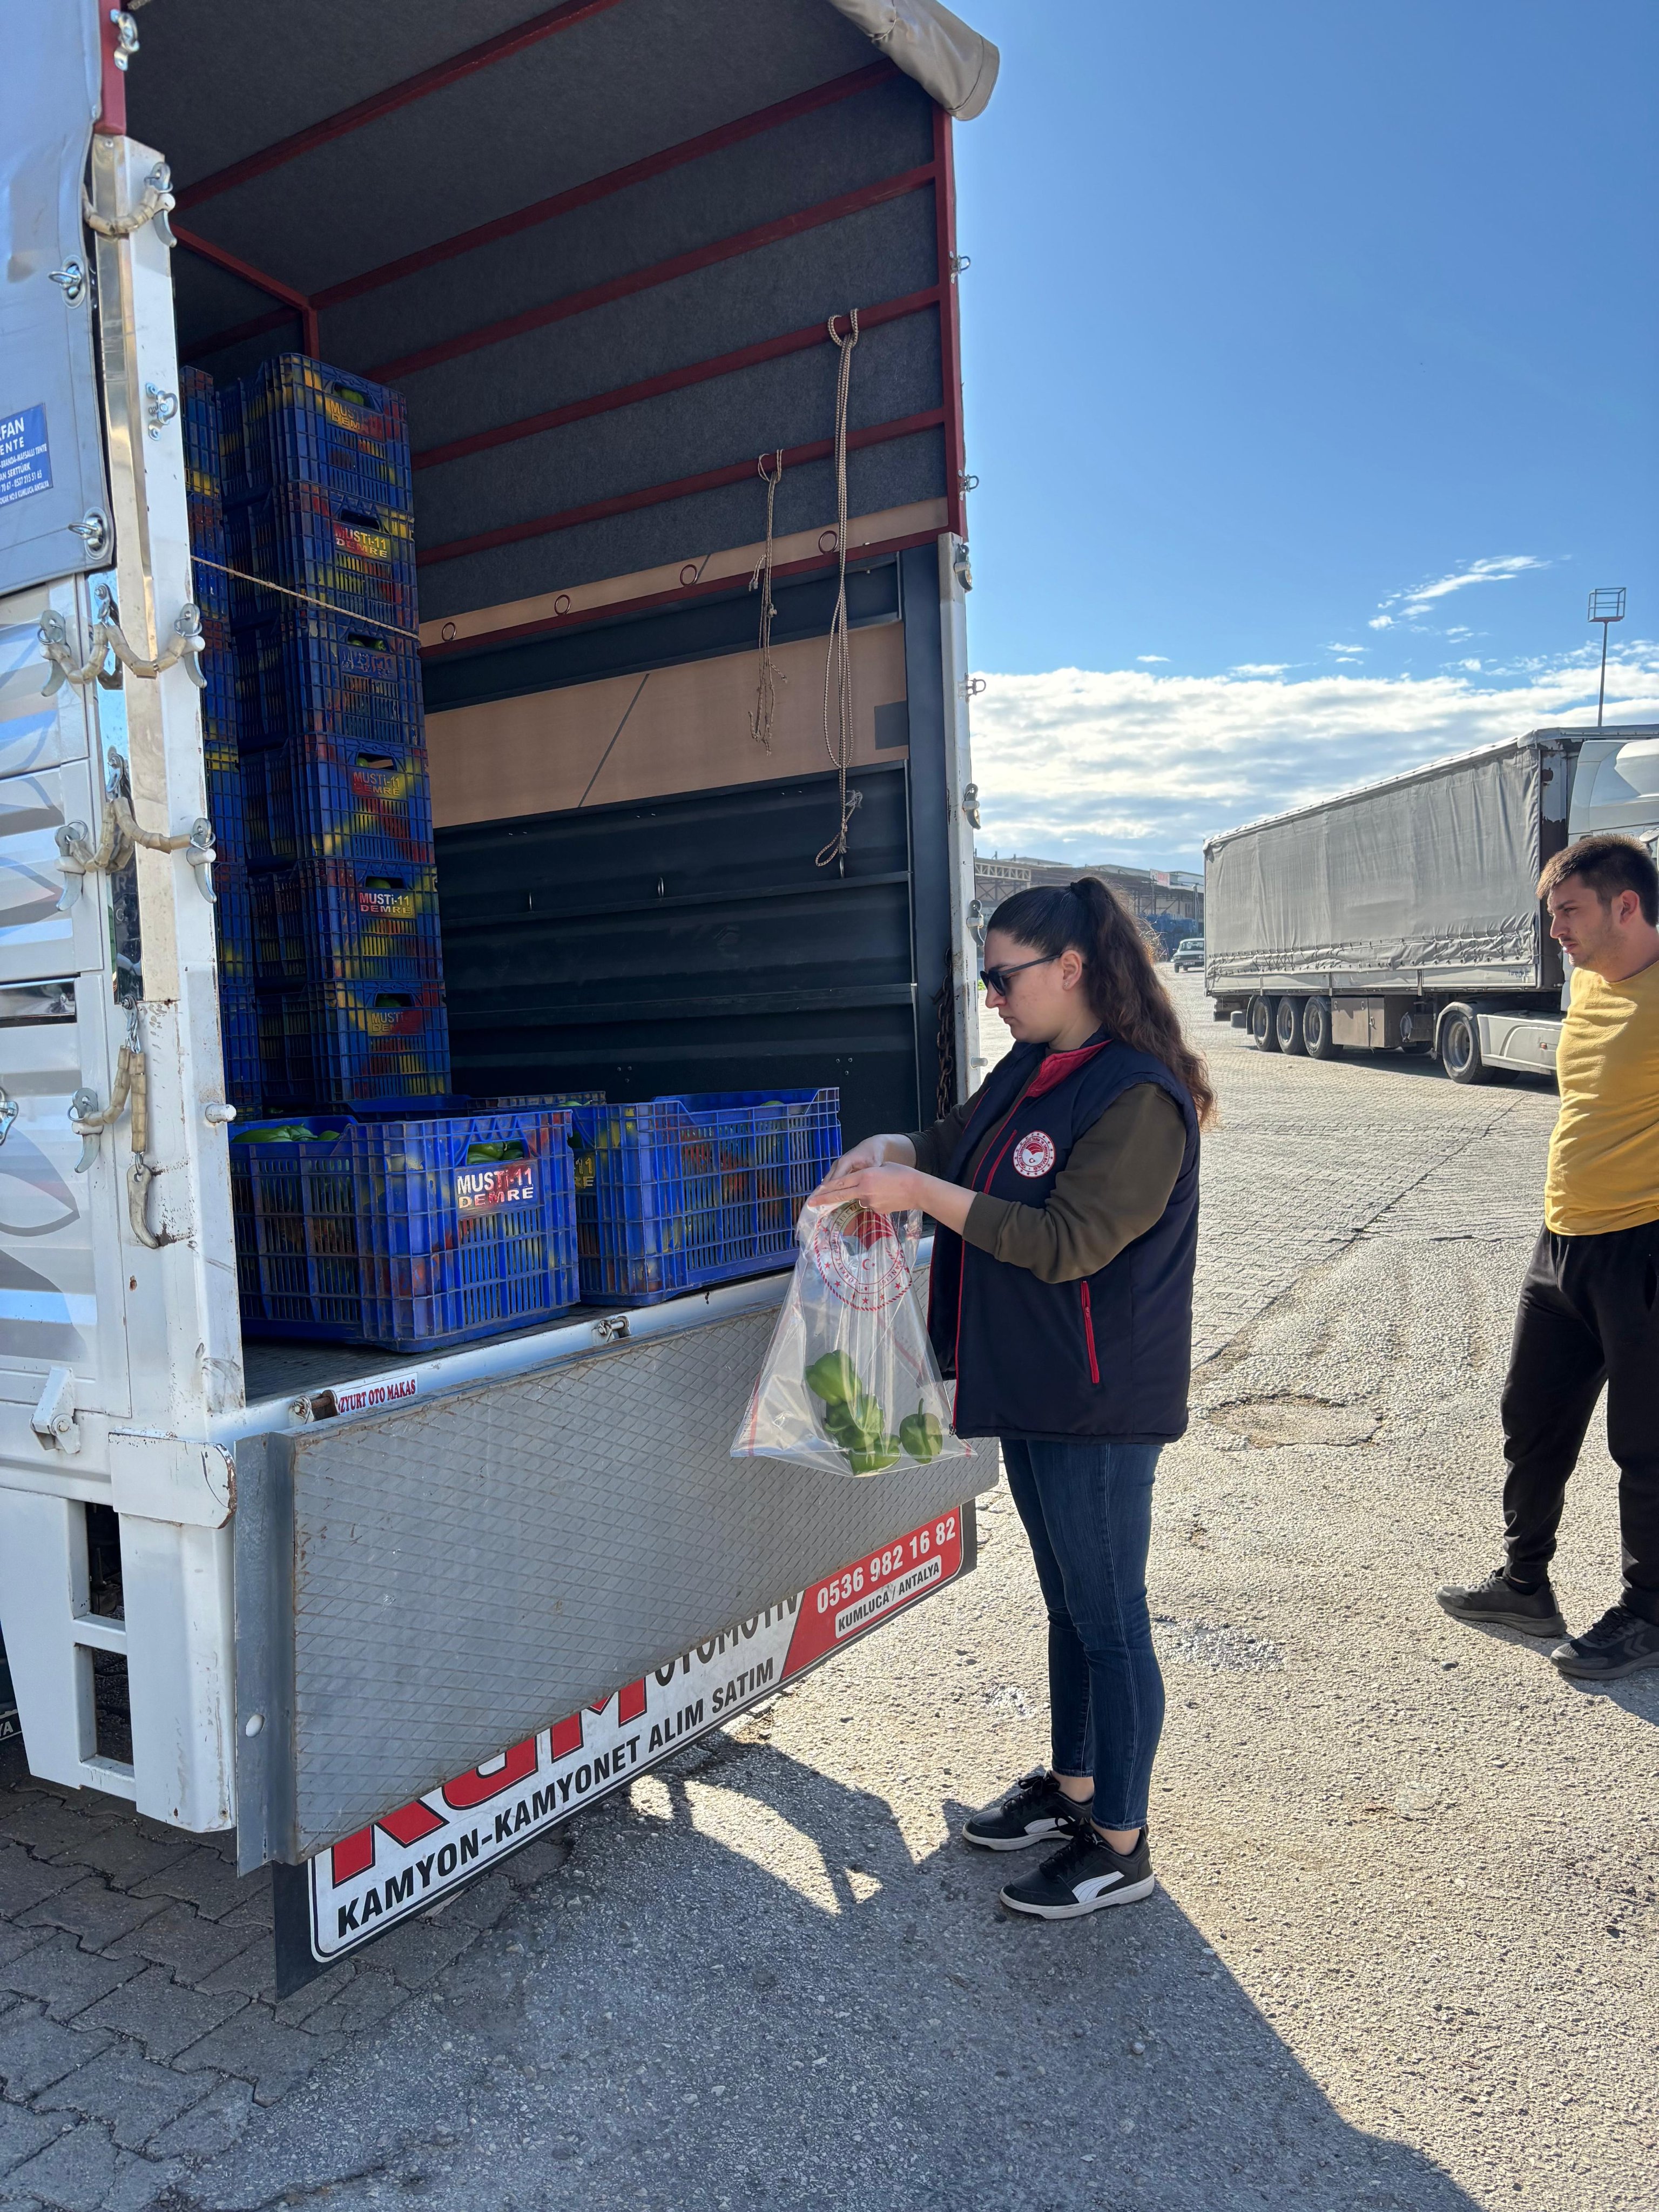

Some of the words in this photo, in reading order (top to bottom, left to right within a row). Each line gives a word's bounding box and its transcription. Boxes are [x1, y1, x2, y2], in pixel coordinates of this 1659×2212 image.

[0, 417, 24, 441] FAN
[336, 537, 387, 558] DEMRE
[360, 905, 411, 914] DEMRE
[458, 1186, 534, 1209] DEMRE
[368, 1387, 385, 1406] OTO
[387, 1379, 416, 1401] MAKAS
[817, 1567, 864, 1613] 0536
[870, 1545, 902, 1582] 982
[909, 1530, 929, 1559] 16
[936, 1516, 955, 1546] 82
[838, 1591, 889, 1632] KUMLUCA
[899, 1562, 939, 1596] ANTALYA
[337, 1734, 640, 1939] KAMYON-KAMYONET
[649, 1698, 703, 1752] ALIM
[712, 1656, 773, 1714] SATIM
